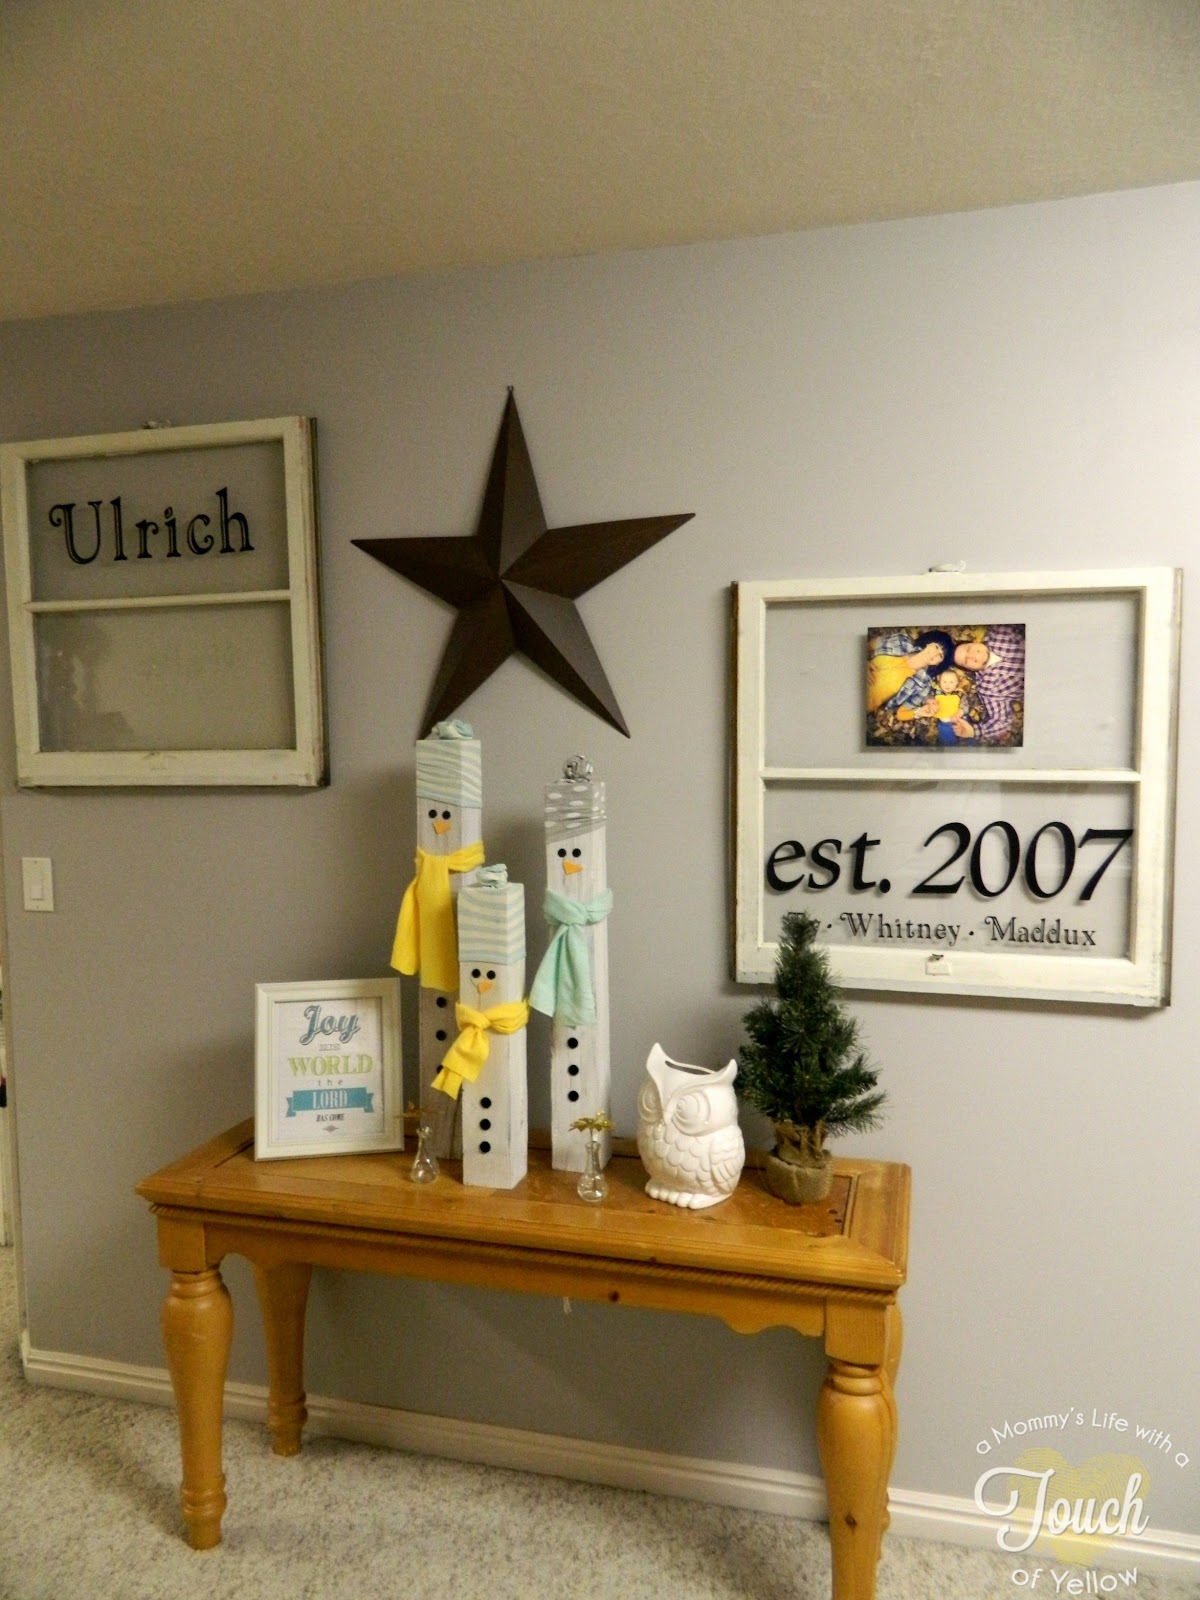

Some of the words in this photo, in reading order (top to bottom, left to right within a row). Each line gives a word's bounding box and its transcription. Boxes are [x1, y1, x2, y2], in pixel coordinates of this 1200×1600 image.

[50, 486, 255, 565] Ulrich
[765, 832, 891, 895] est.
[911, 820, 1134, 901] 2007
[840, 911, 961, 947] Whitney
[984, 915, 1097, 947] Maddux
[299, 1004, 362, 1046] Joy
[287, 1054, 374, 1077] WORLD
[317, 1079, 343, 1087] the
[312, 1090, 348, 1110] LORD
